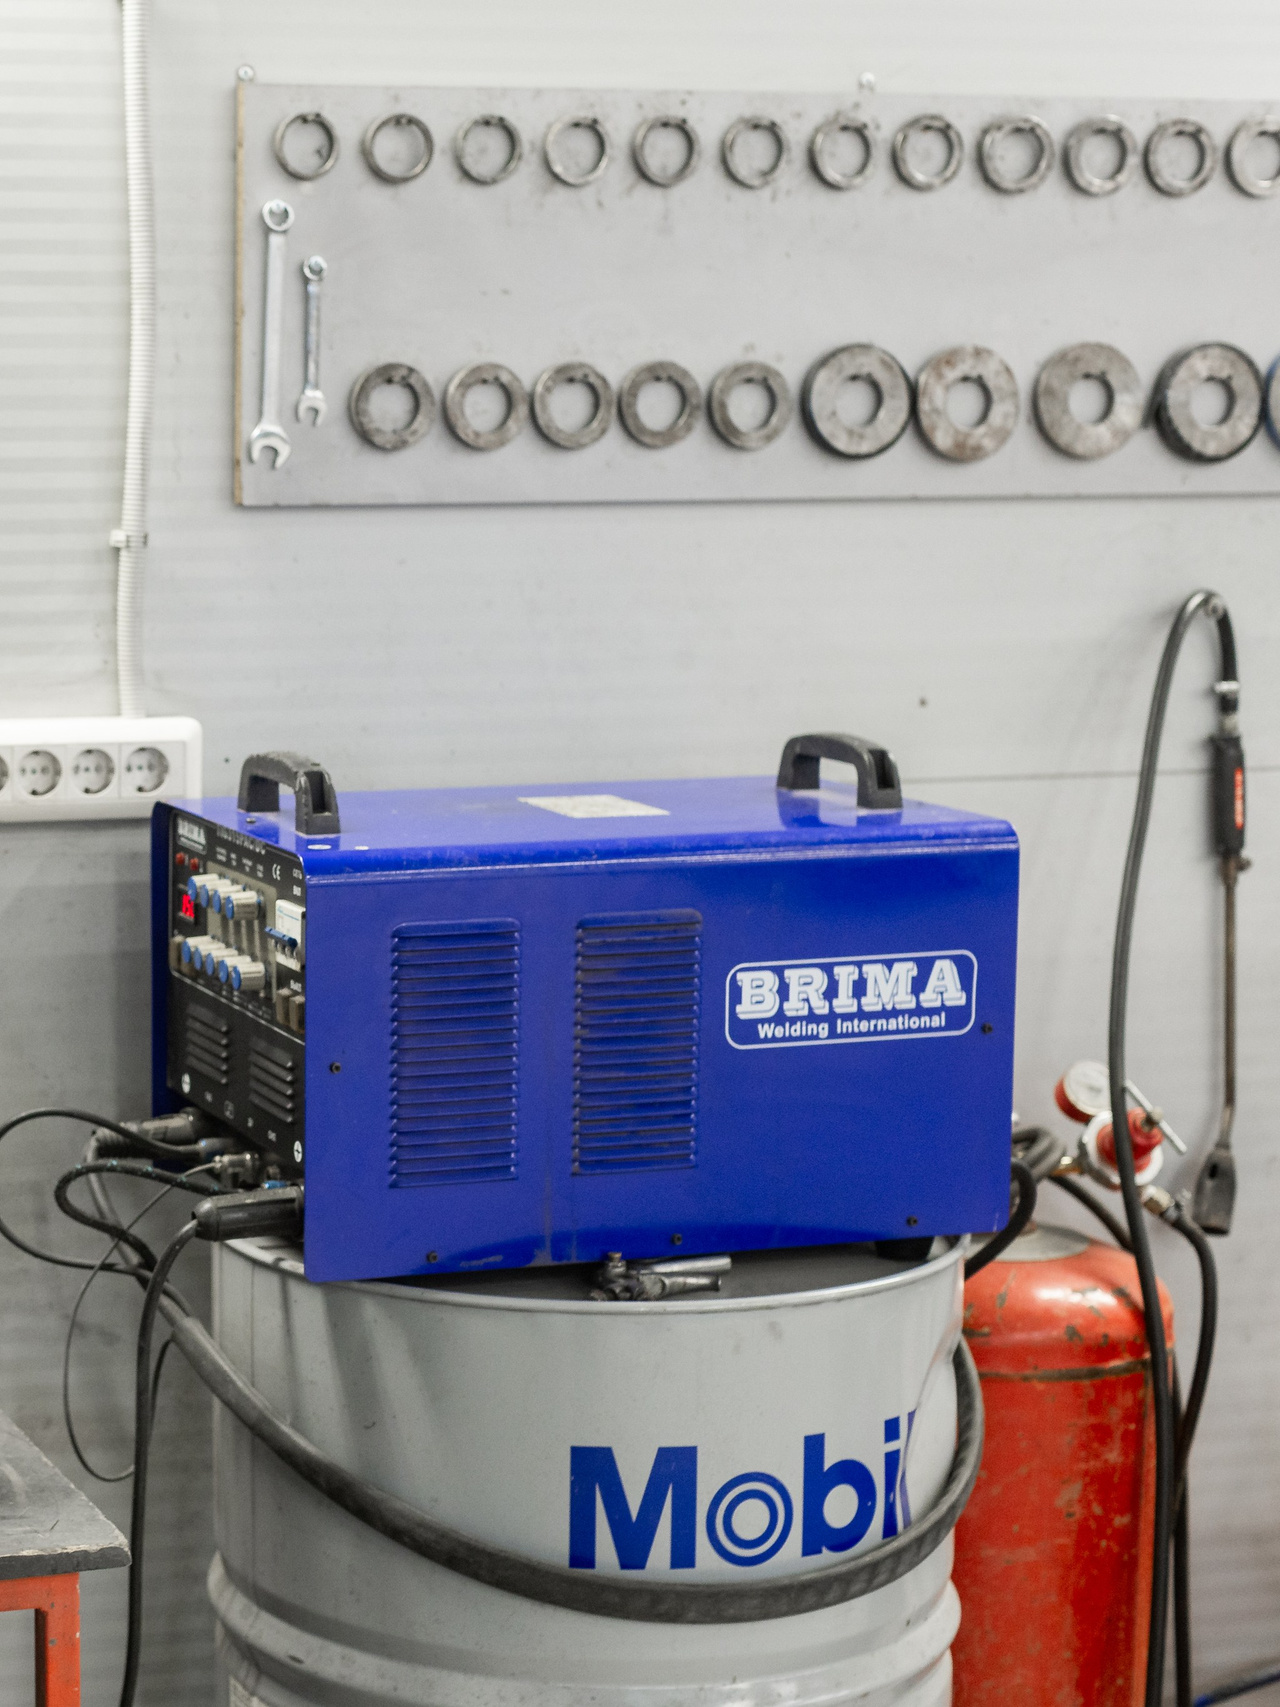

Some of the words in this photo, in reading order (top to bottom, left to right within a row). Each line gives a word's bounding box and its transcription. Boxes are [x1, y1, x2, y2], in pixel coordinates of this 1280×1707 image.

[735, 958, 967, 1019] BRIMA
[757, 1020, 829, 1039] Welding
[837, 1011, 946, 1034] International
